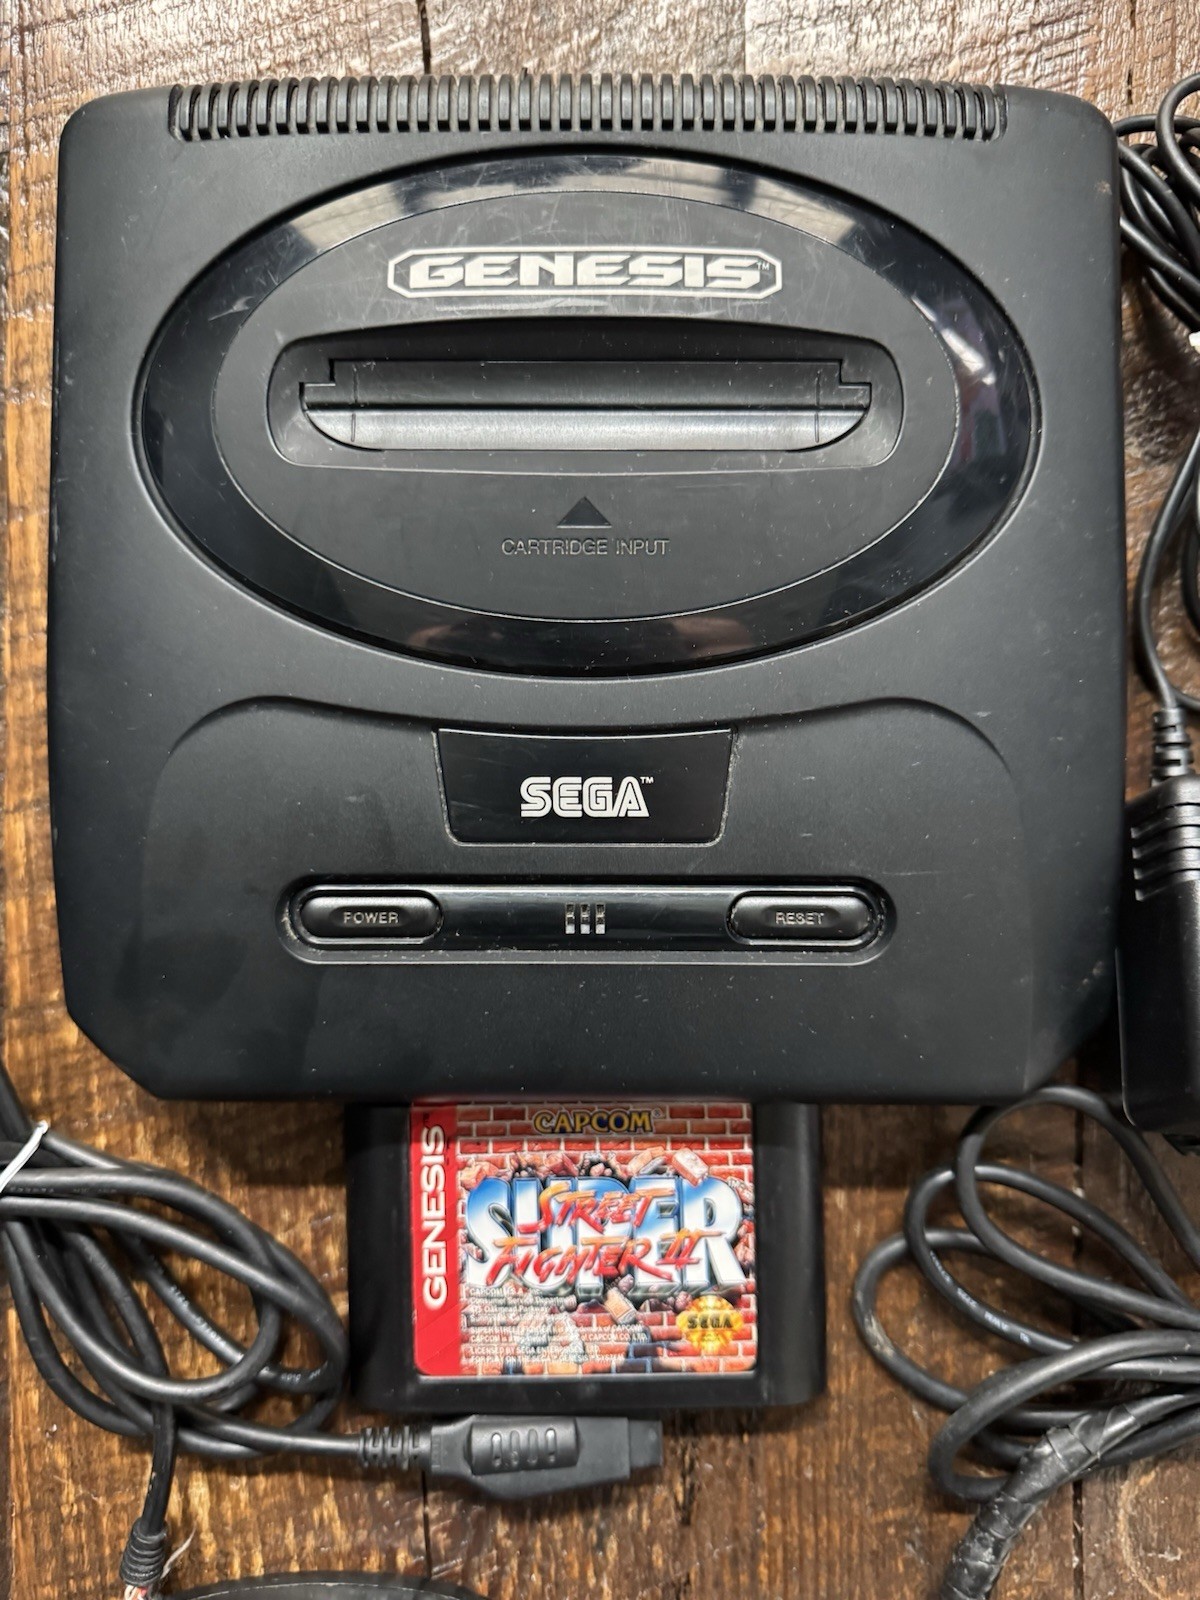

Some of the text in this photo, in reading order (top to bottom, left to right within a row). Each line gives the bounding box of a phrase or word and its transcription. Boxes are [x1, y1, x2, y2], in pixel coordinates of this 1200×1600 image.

[409, 253, 761, 290] GENESIS
[501, 539, 670, 555] CARTRIDGE INPUT
[519, 776, 650, 818] SEGA
[343, 911, 399, 924] POWER
[775, 911, 825, 925] RESET
[533, 1110, 653, 1134] CAPCOM
[420, 1125, 447, 1309] GENESIS
[516, 1181, 676, 1234] STREET
[485, 1228, 727, 1287] FIGHTER II
[687, 1313, 733, 1329] SEGA
